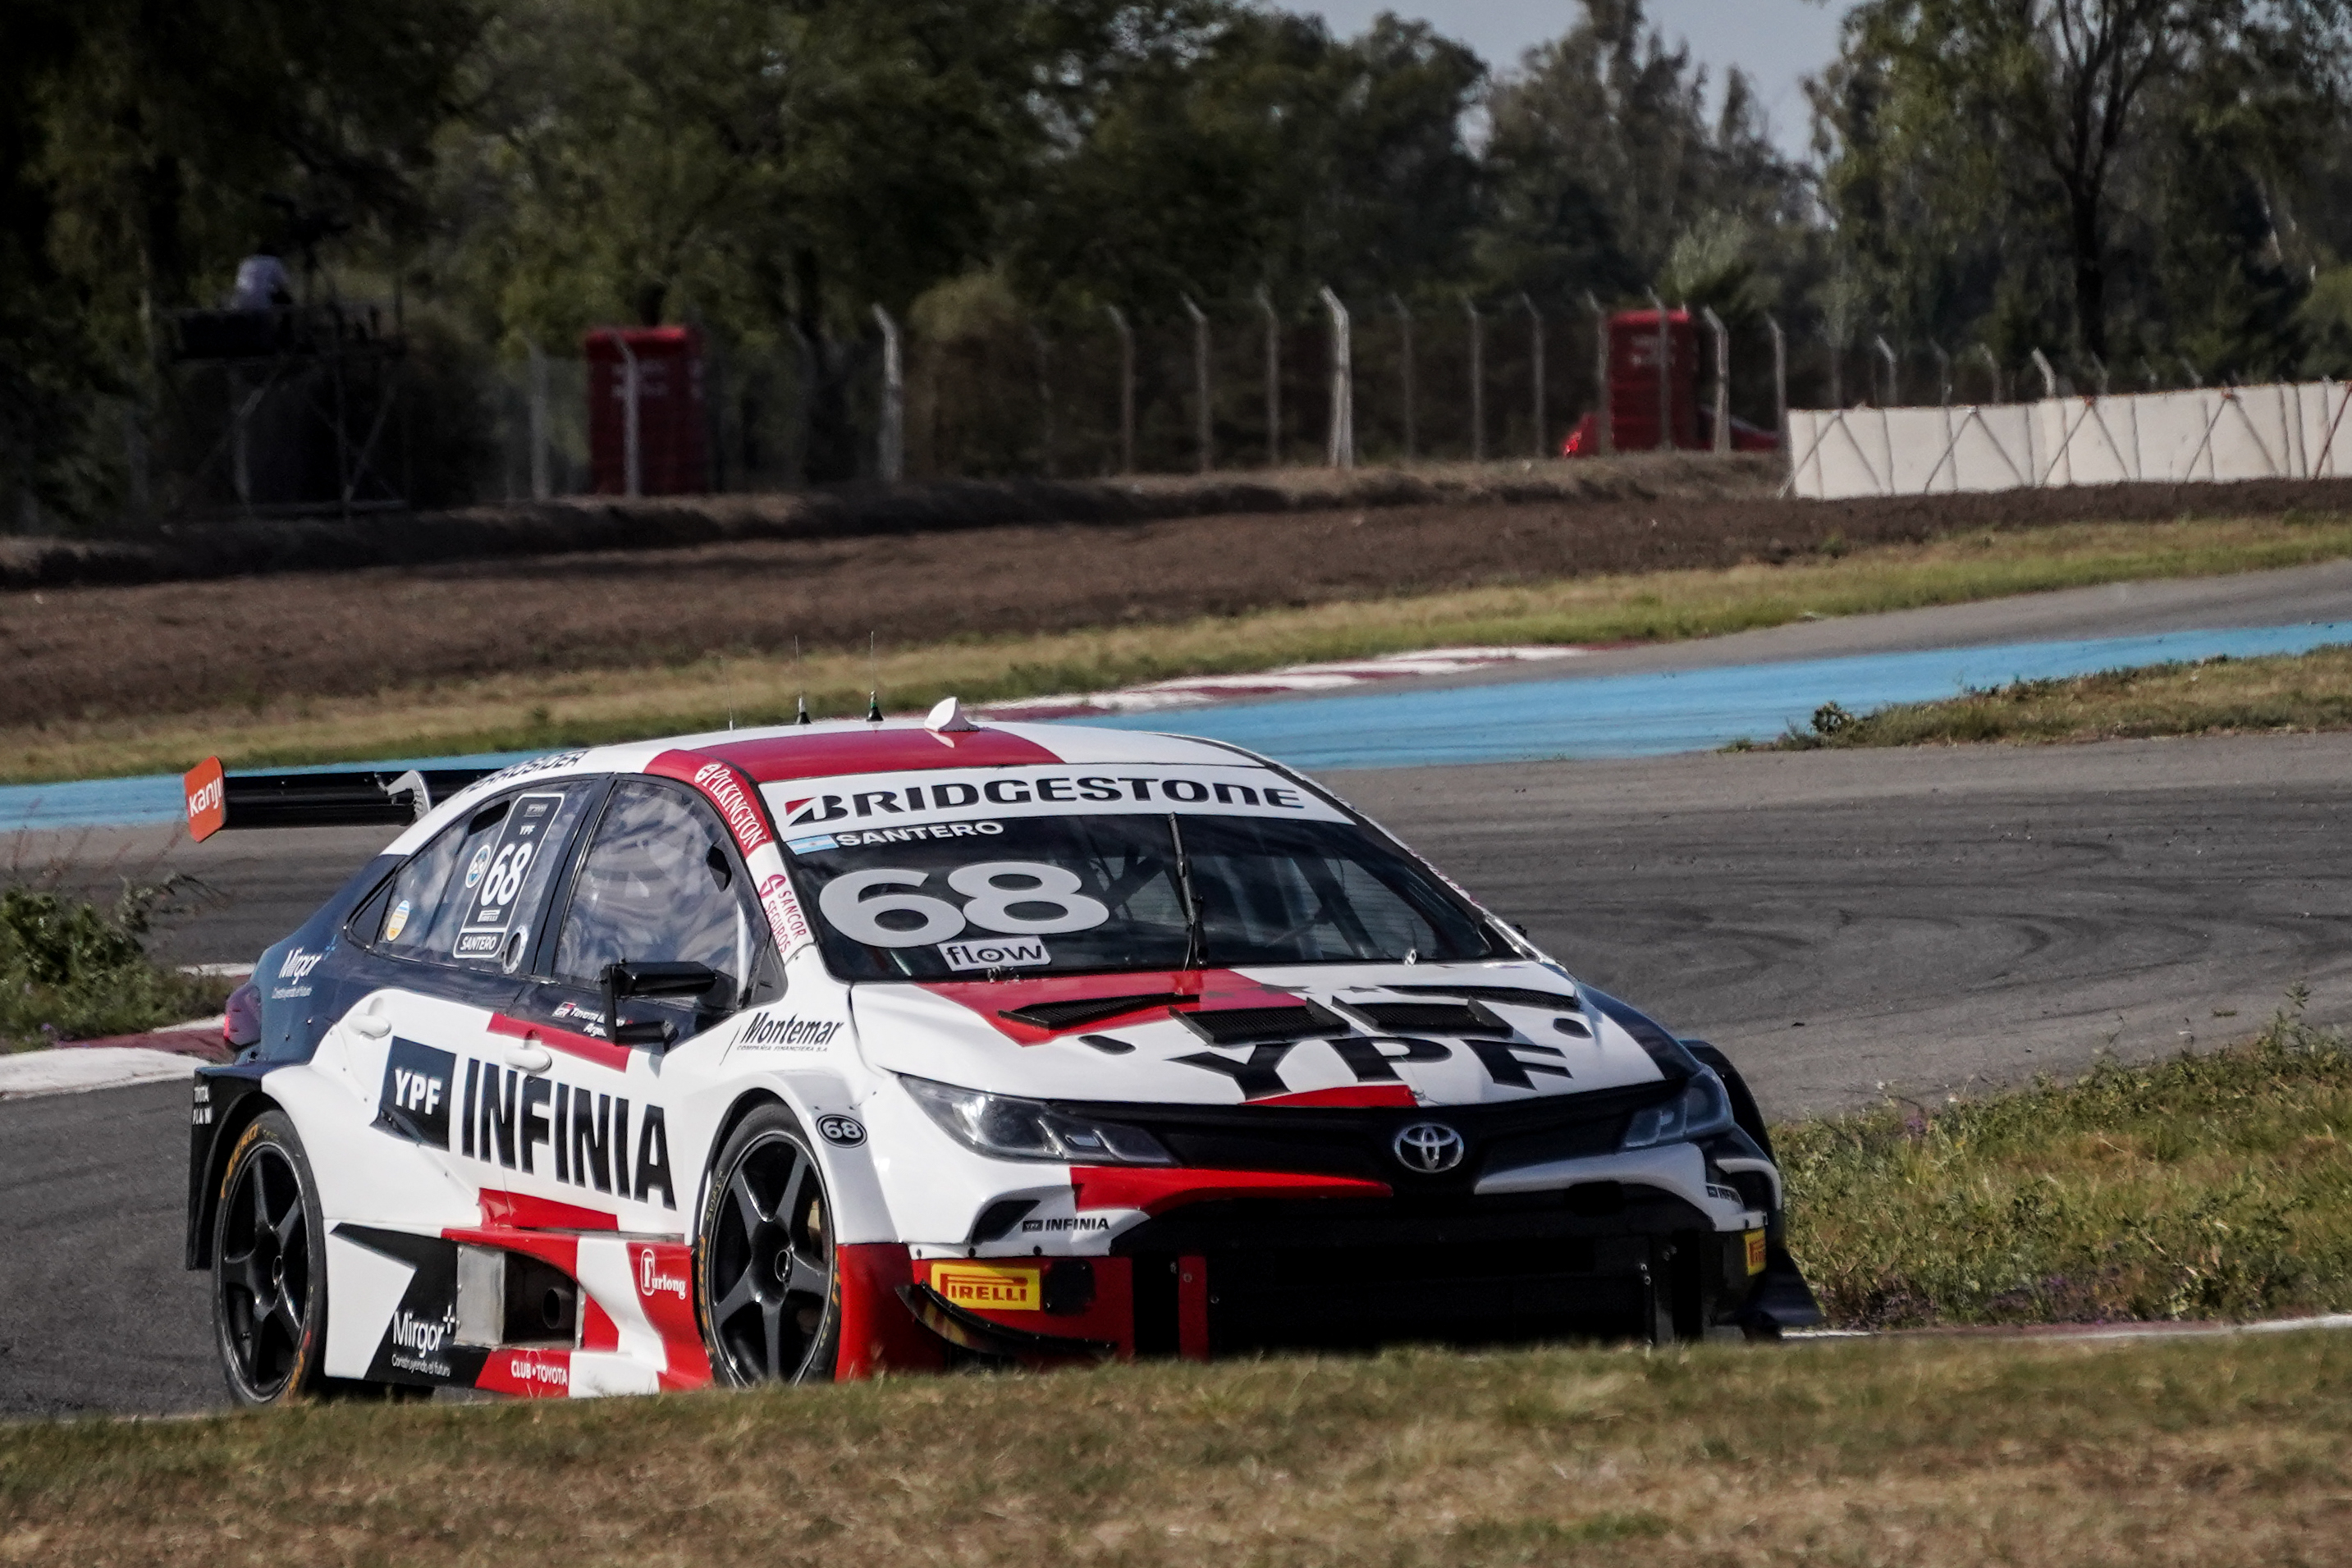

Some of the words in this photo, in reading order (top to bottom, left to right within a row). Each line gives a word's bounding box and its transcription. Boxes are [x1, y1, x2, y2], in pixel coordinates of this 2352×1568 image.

[189, 777, 222, 817] kanji
[702, 768, 767, 850] PILKINGTON
[787, 776, 1306, 827] BRIDGESTONE
[519, 824, 536, 835] YPF
[836, 822, 1004, 848] SANTERO
[480, 843, 533, 906] 68
[778, 890, 807, 941] SANCOR
[819, 862, 1110, 948] 68
[460, 935, 496, 950] SANTERO
[764, 899, 791, 953] SEGUROS
[278, 946, 323, 985] Mirgor
[946, 943, 1045, 969] flow
[739, 1012, 844, 1045] Montemar
[1166, 1035, 1574, 1101] YPF
[394, 1067, 442, 1116] YPF
[461, 1058, 677, 1211] INFINIA
[821, 1119, 862, 1141] 68
[1045, 1218, 1110, 1231] INFINIA
[940, 1273, 1029, 1301] PIRELLI
[393, 1311, 445, 1358] Mirgor
[510, 1360, 531, 1379] CLUB
[535, 1365, 568, 1385] TOYOTA
